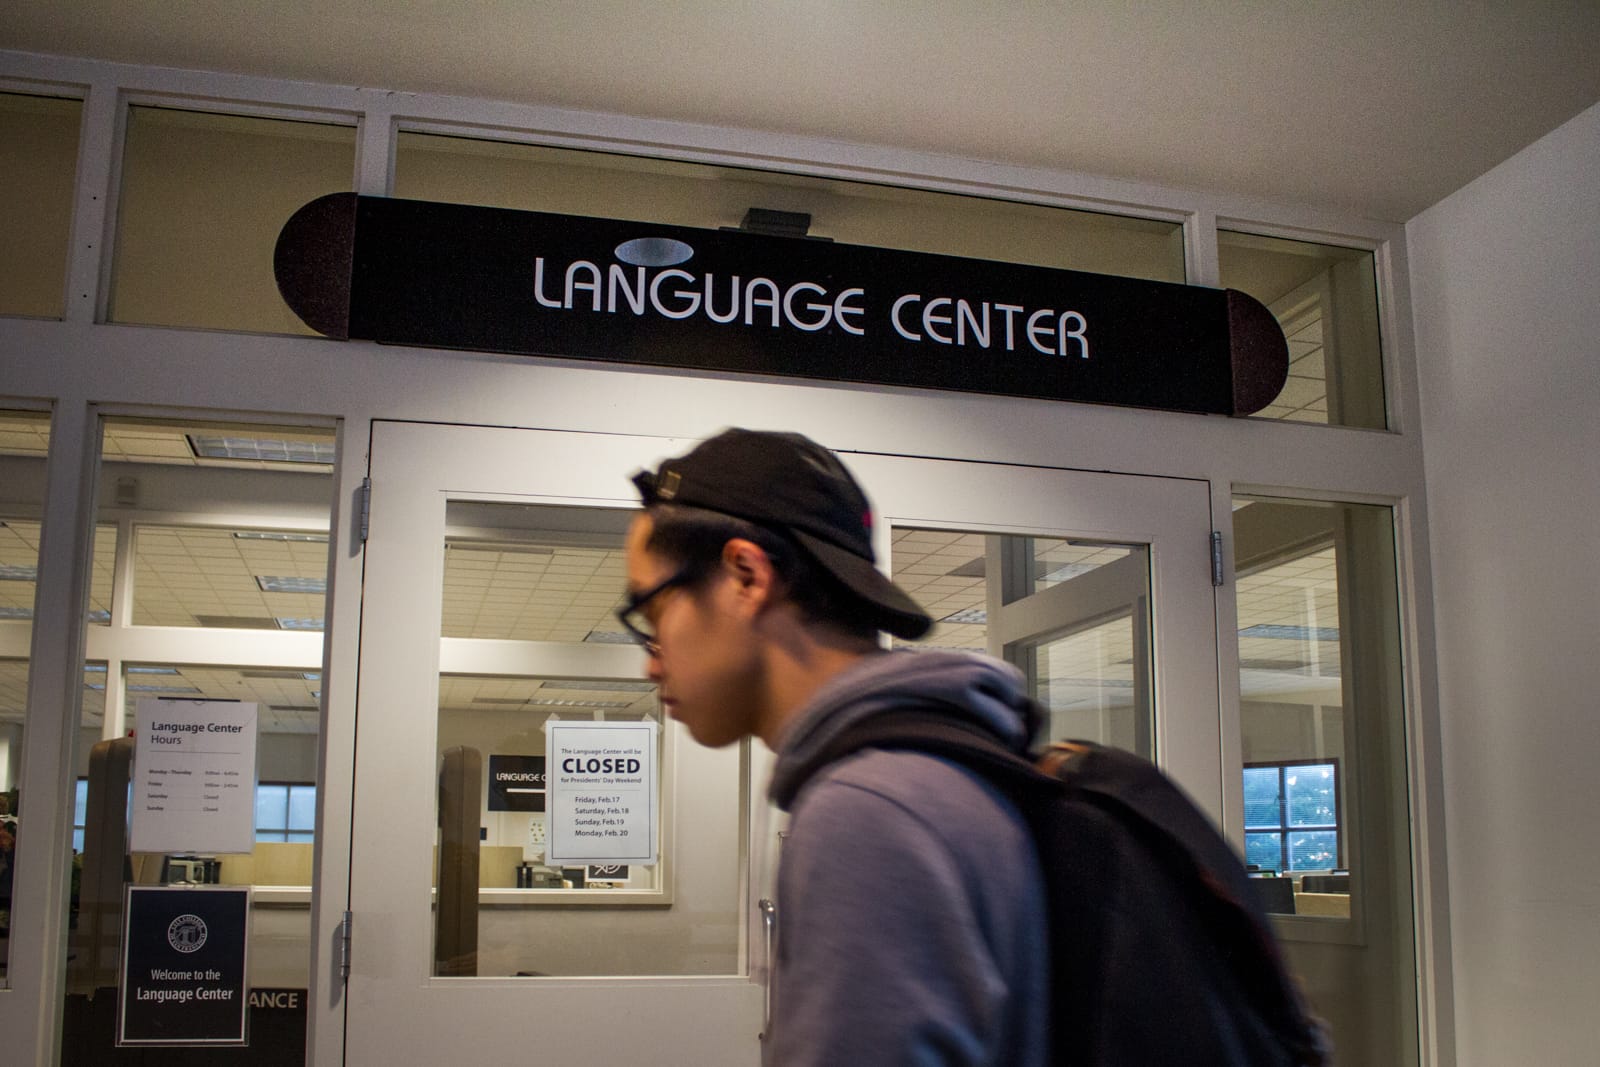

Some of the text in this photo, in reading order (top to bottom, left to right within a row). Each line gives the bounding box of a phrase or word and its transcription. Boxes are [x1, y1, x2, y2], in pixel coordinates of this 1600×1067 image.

[534, 257, 1090, 359] LANGUAGE CENTER
[152, 721, 243, 734] Language Center
[151, 735, 182, 745] Hours
[573, 748, 602, 756] Language
[562, 758, 641, 774] CLOSED
[496, 772, 540, 782] LANGUAGE
[603, 777, 614, 785] Day
[575, 796, 597, 805] Friday,
[575, 807, 606, 816] Saturday,
[575, 818, 601, 827] Sunday,
[575, 829, 604, 838] Monday,
[151, 969, 221, 980] Welcome to the
[137, 987, 234, 1003] Language Center
